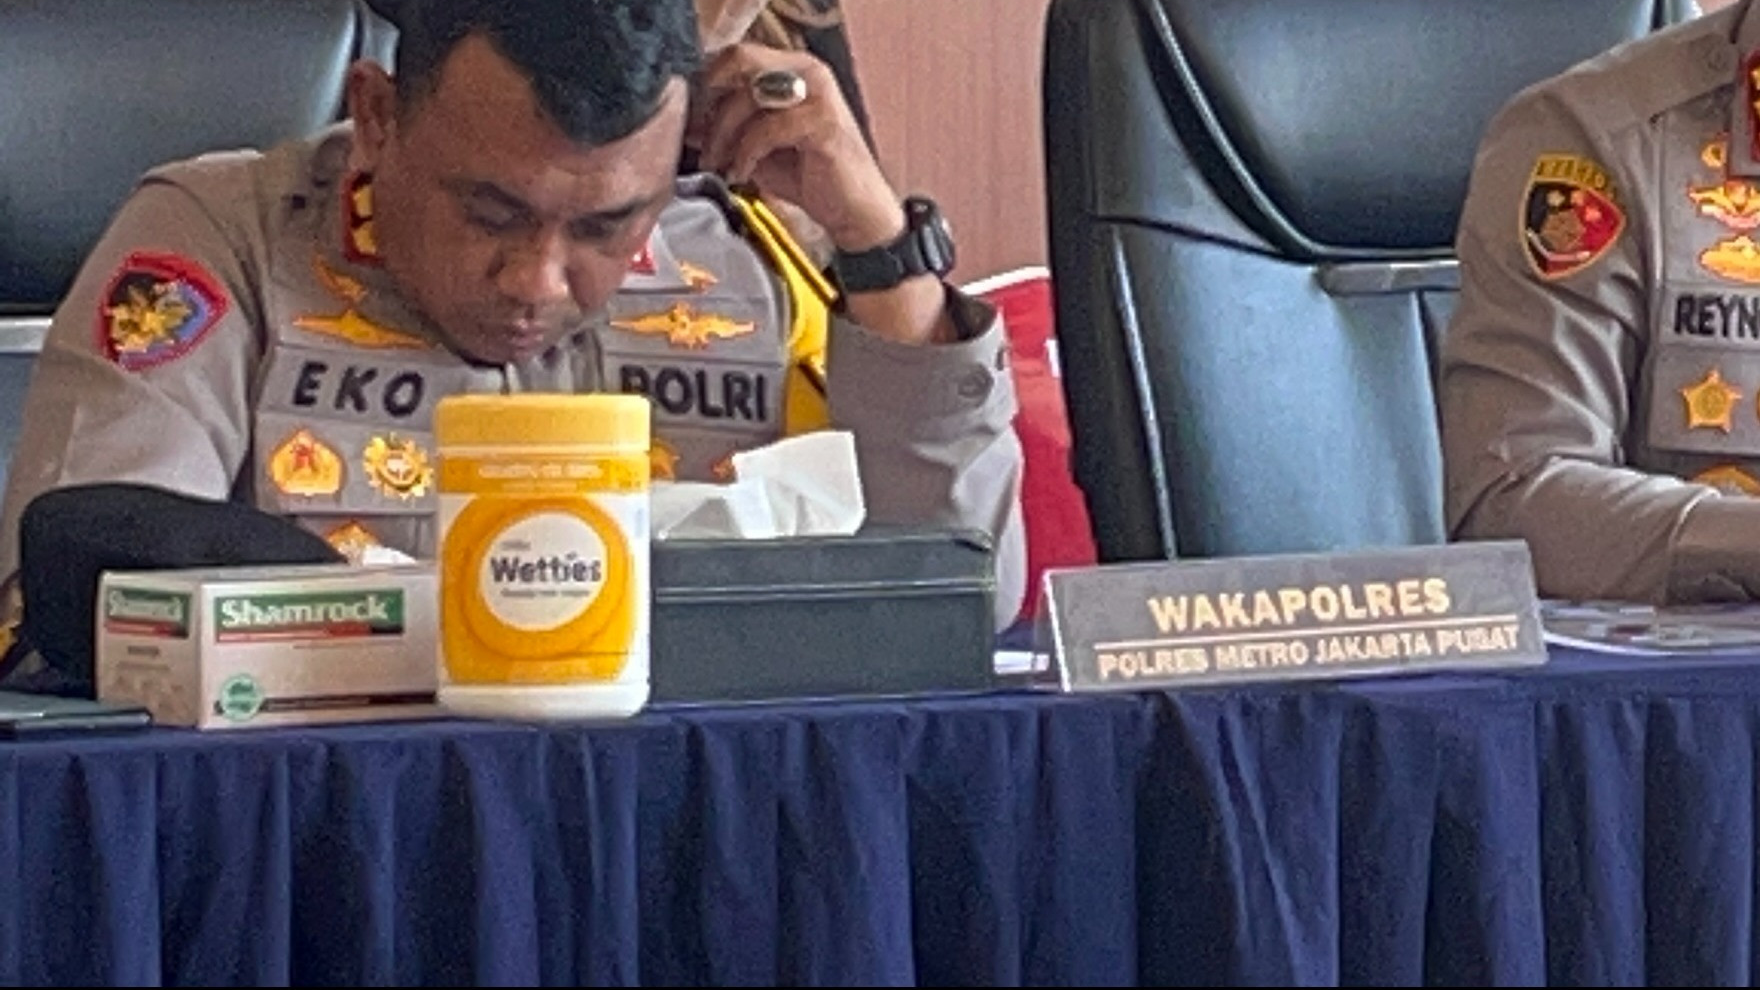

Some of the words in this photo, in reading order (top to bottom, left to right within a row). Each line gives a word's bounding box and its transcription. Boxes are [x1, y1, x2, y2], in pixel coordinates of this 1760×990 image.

[293, 361, 426, 417] EKO
[619, 364, 767, 421] POLRI
[490, 551, 602, 584] Wetties
[221, 594, 389, 627] Shamrock
[1147, 578, 1451, 633] WAKAPOLRES
[1097, 646, 1208, 679] POLRES
[1216, 638, 1307, 670] METRO
[1314, 630, 1431, 664] JAKARTA
